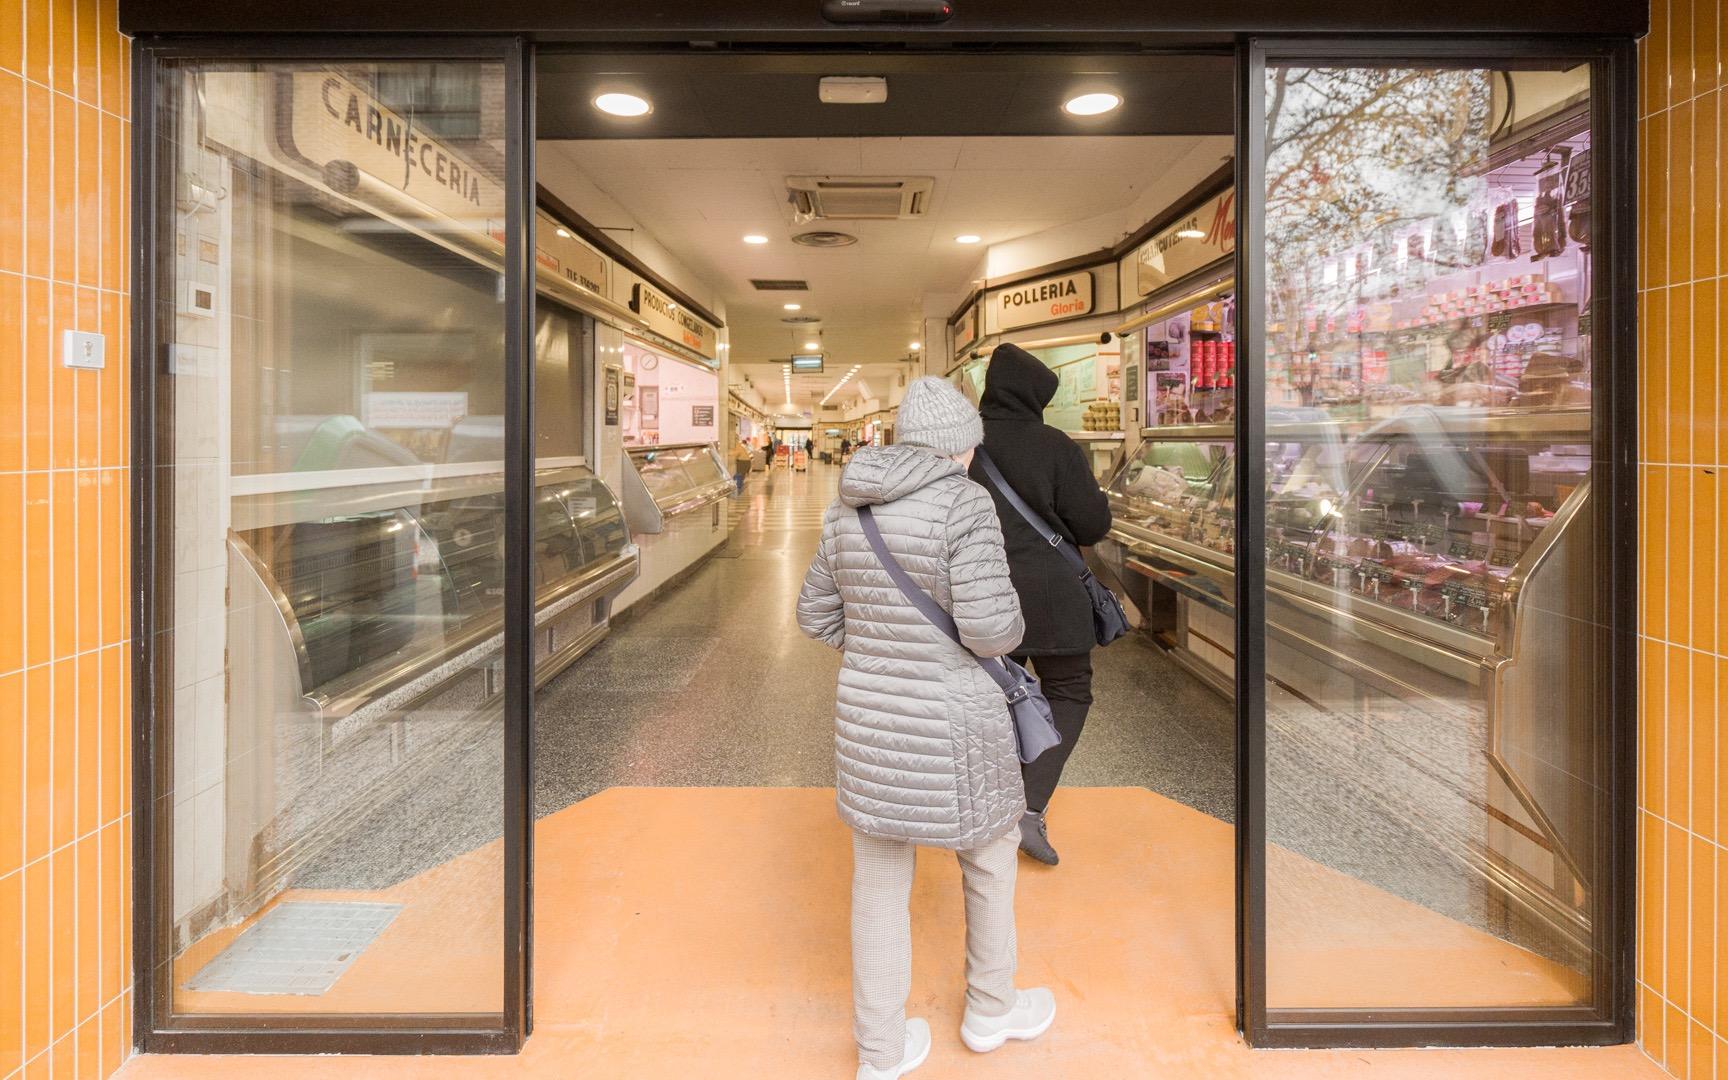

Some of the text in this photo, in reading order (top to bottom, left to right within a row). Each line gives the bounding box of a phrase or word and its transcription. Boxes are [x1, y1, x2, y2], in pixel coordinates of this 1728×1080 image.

[321, 78, 480, 206] CARNECERIA
[1003, 279, 1077, 309] POLLERIA
[1050, 299, 1085, 317] Gloria
